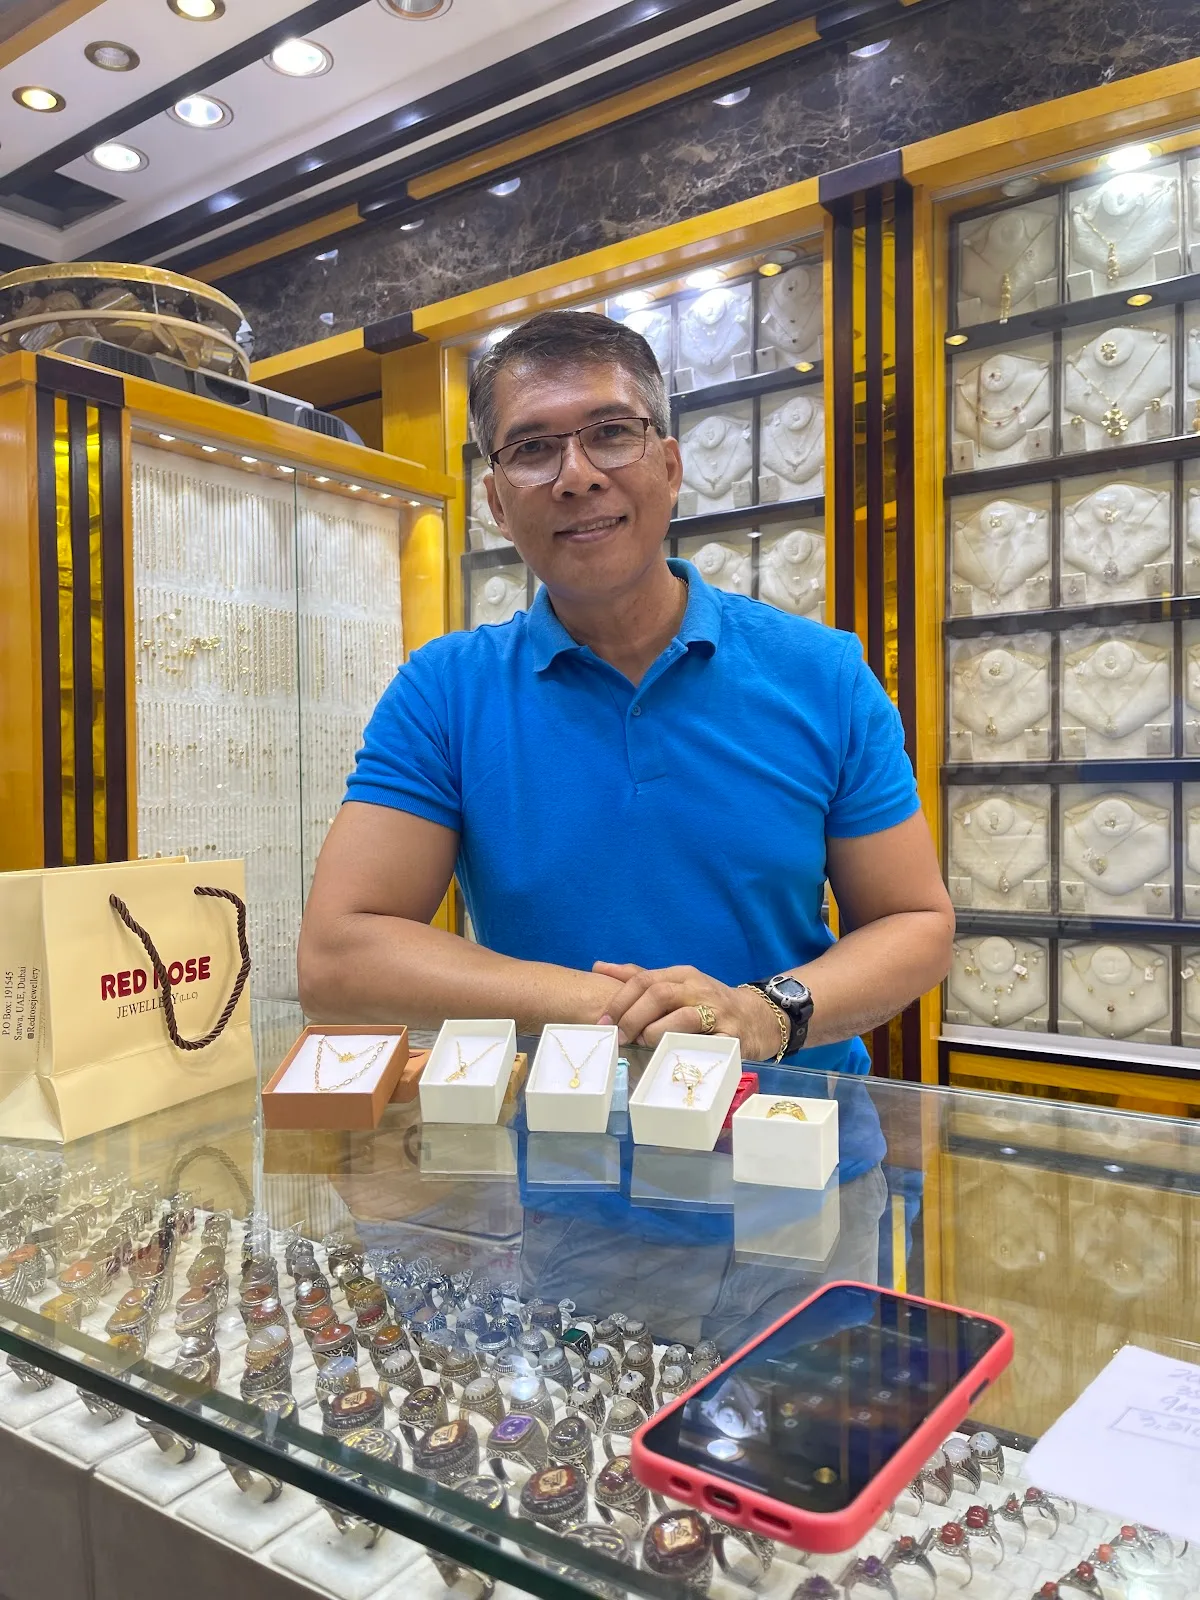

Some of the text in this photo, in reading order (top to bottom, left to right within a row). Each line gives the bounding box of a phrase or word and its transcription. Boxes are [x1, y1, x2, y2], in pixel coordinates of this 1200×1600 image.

[5, 971, 14, 999] 191545
[101, 969, 147, 1001] RED
[3, 1001, 12, 1020] Box:
[14, 966, 27, 1041] Satwa, UAE, Dubai
[116, 992, 179, 1019] JEWELLEY
